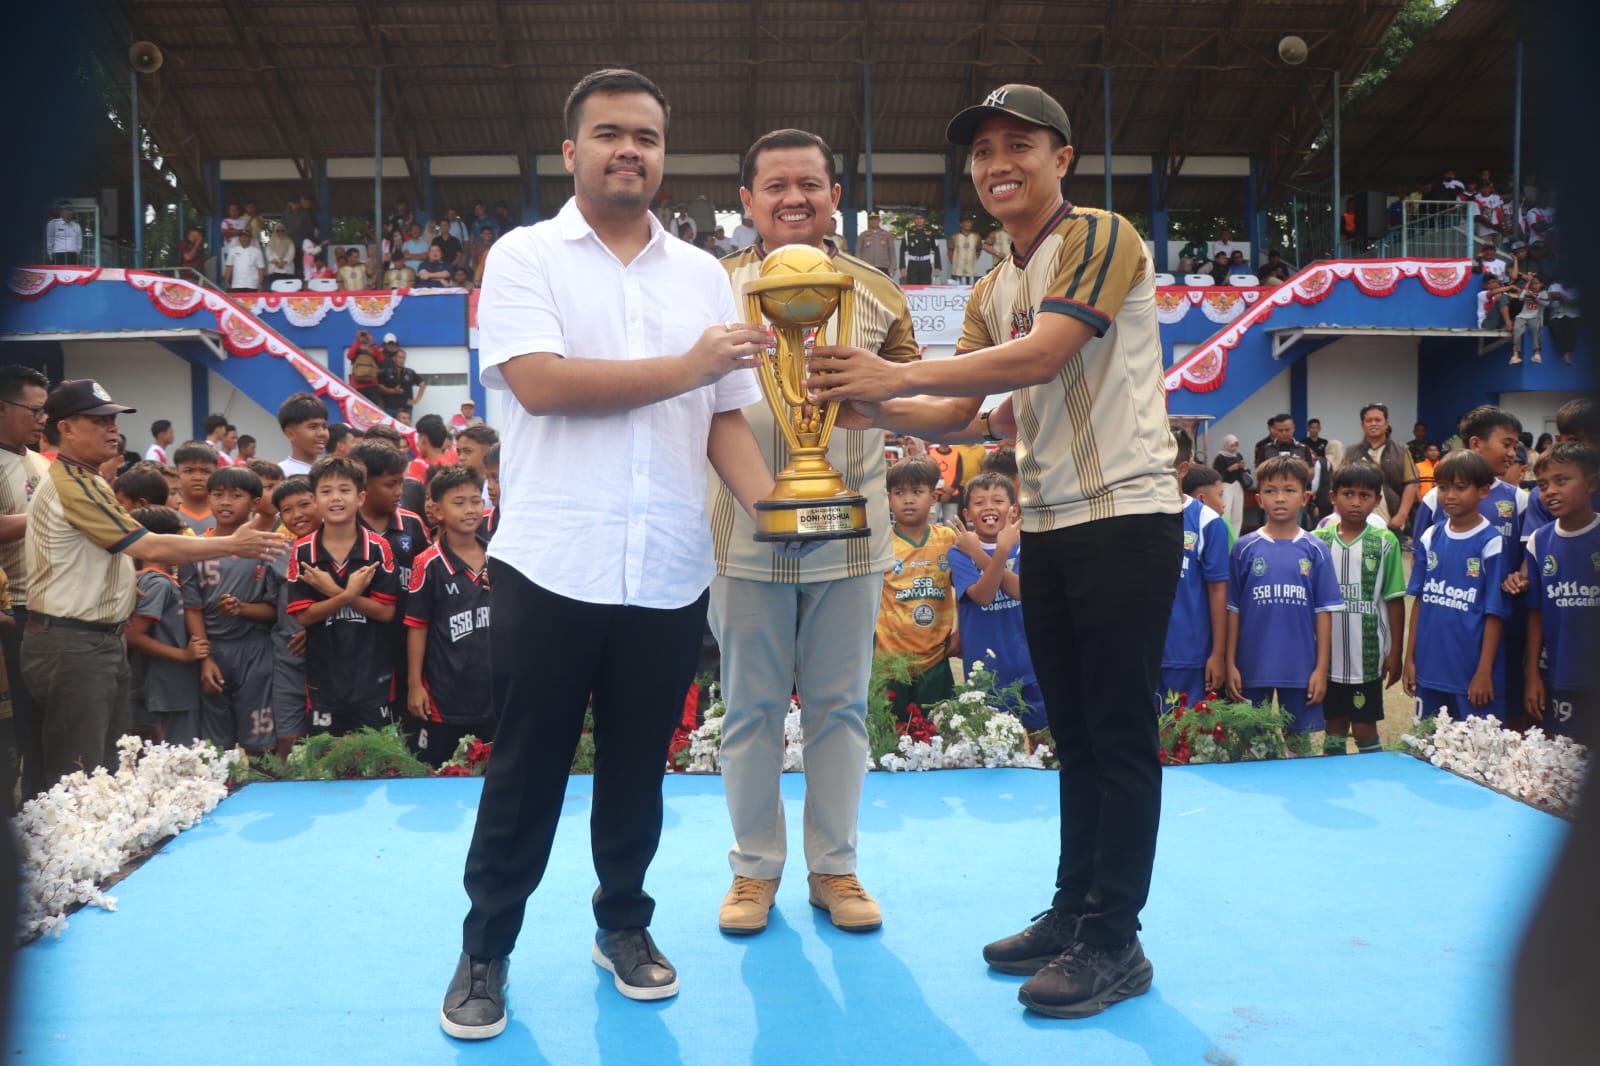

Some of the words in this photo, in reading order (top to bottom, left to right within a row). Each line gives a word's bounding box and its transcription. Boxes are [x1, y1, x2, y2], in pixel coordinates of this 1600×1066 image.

[800, 512, 850, 523] DONI-YOSHUA
[913, 577, 934, 588] SSB
[1252, 584, 1272, 600] SSB
[449, 610, 474, 643] SSB
[251, 707, 275, 736] 15
